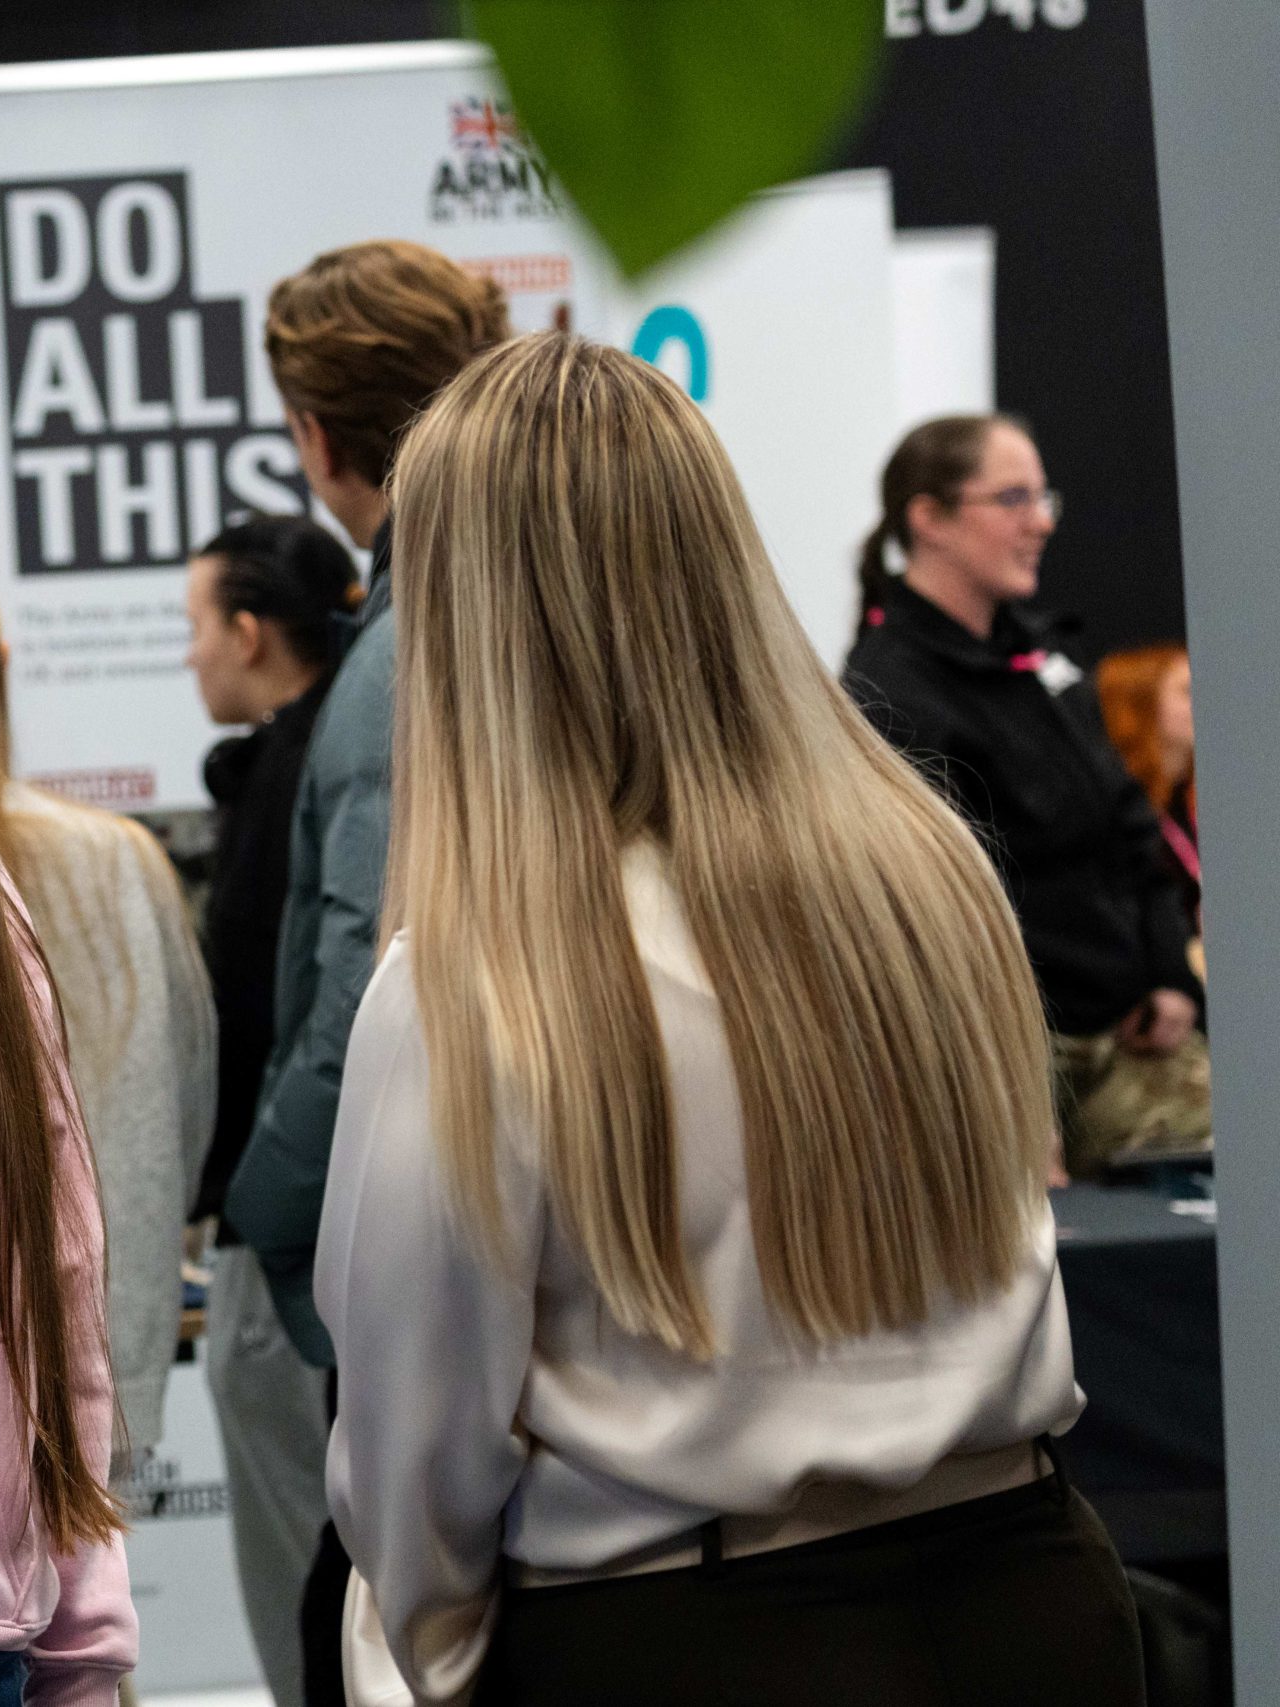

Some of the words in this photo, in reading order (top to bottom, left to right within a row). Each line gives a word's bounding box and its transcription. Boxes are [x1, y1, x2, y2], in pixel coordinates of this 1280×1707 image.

[7, 180, 184, 308] DO
[14, 310, 240, 437] ALL
[14, 434, 304, 566] THIS
